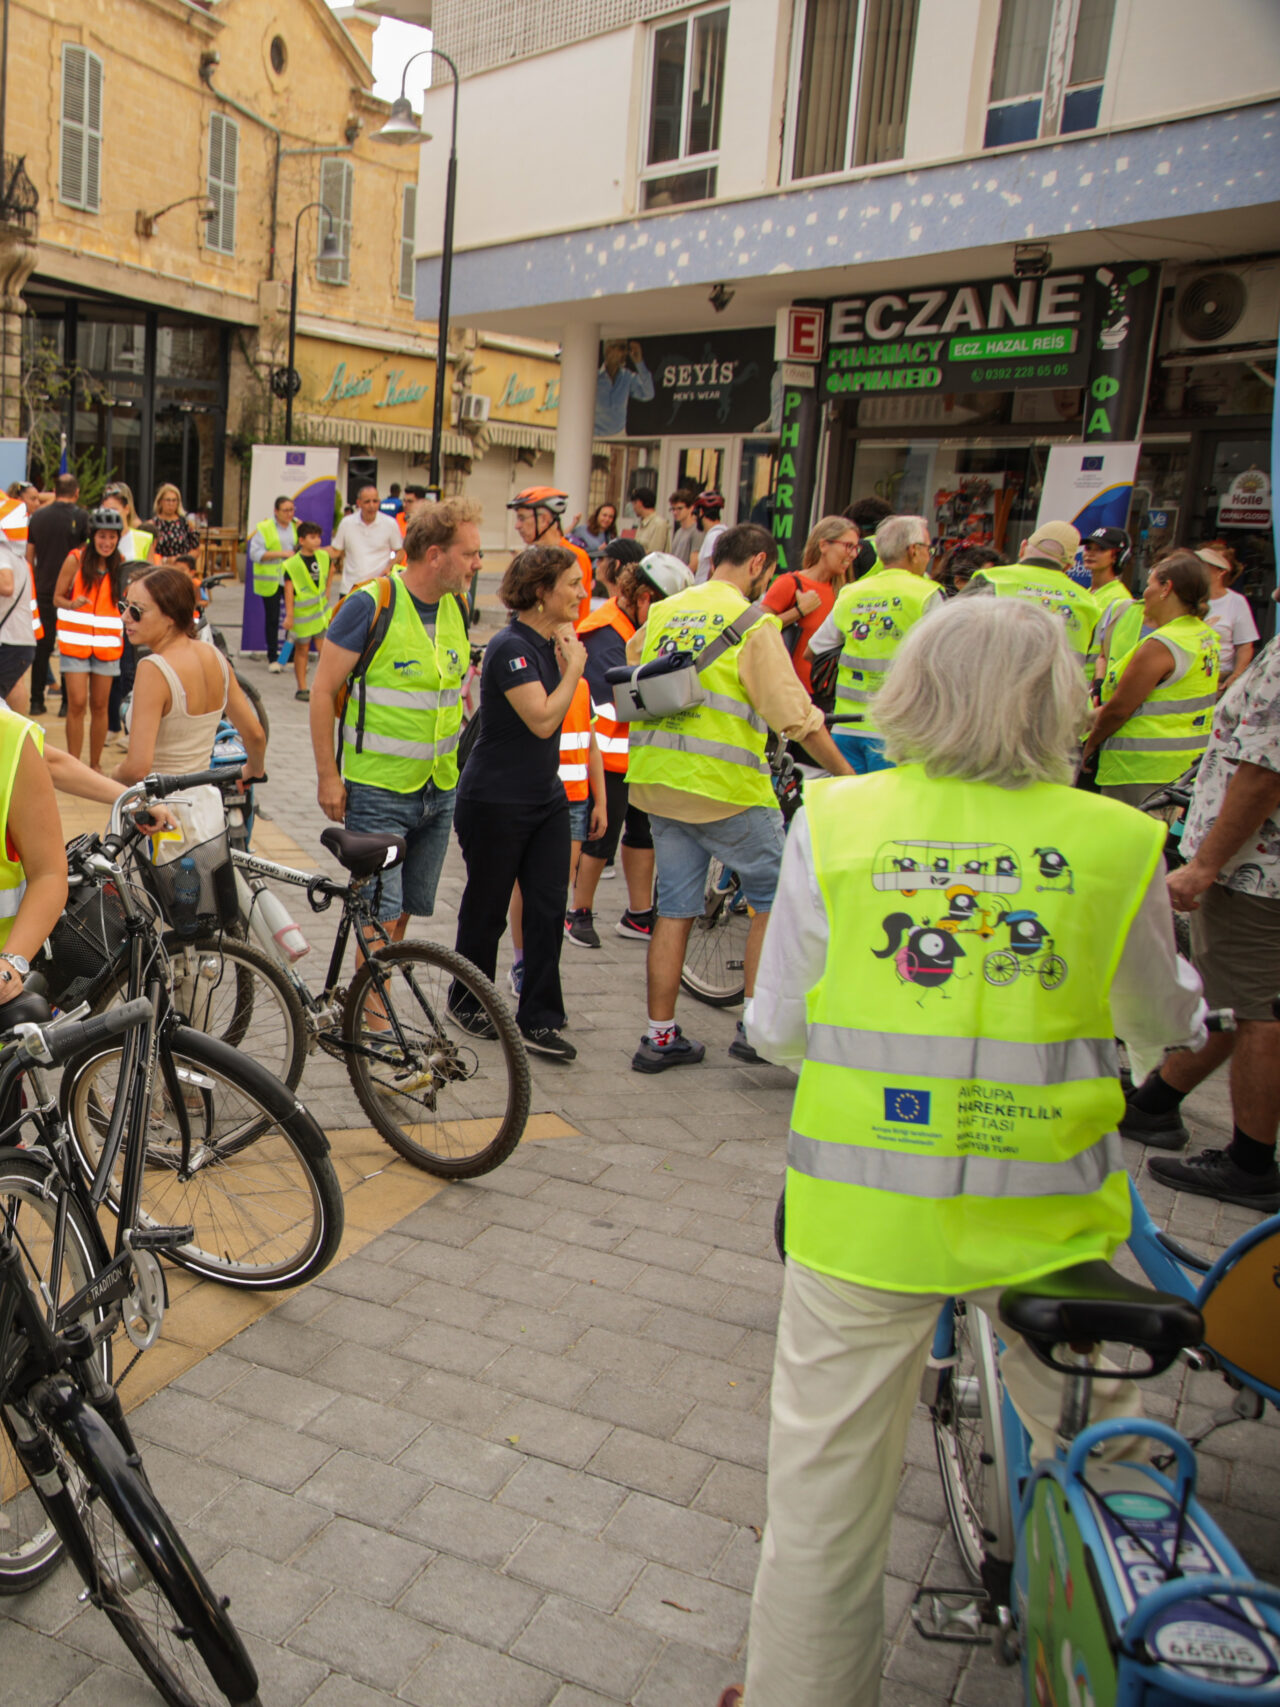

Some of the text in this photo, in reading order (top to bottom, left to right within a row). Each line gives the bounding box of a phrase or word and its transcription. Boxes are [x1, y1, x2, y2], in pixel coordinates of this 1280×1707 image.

[828, 274, 1085, 343] ECZANE
[793, 316, 817, 354] E
[954, 332, 1065, 357] ECZ. HAZAL REİS
[828, 340, 944, 369] PHARMACY
[663, 359, 734, 387] SEYİS
[985, 364, 1069, 380] 0392 228 65 05
[698, 390, 720, 399] WEAR
[772, 391, 802, 578] PHARMA
[1231, 494, 1263, 505] Holle
[90, 1266, 122, 1300] TRADITION
